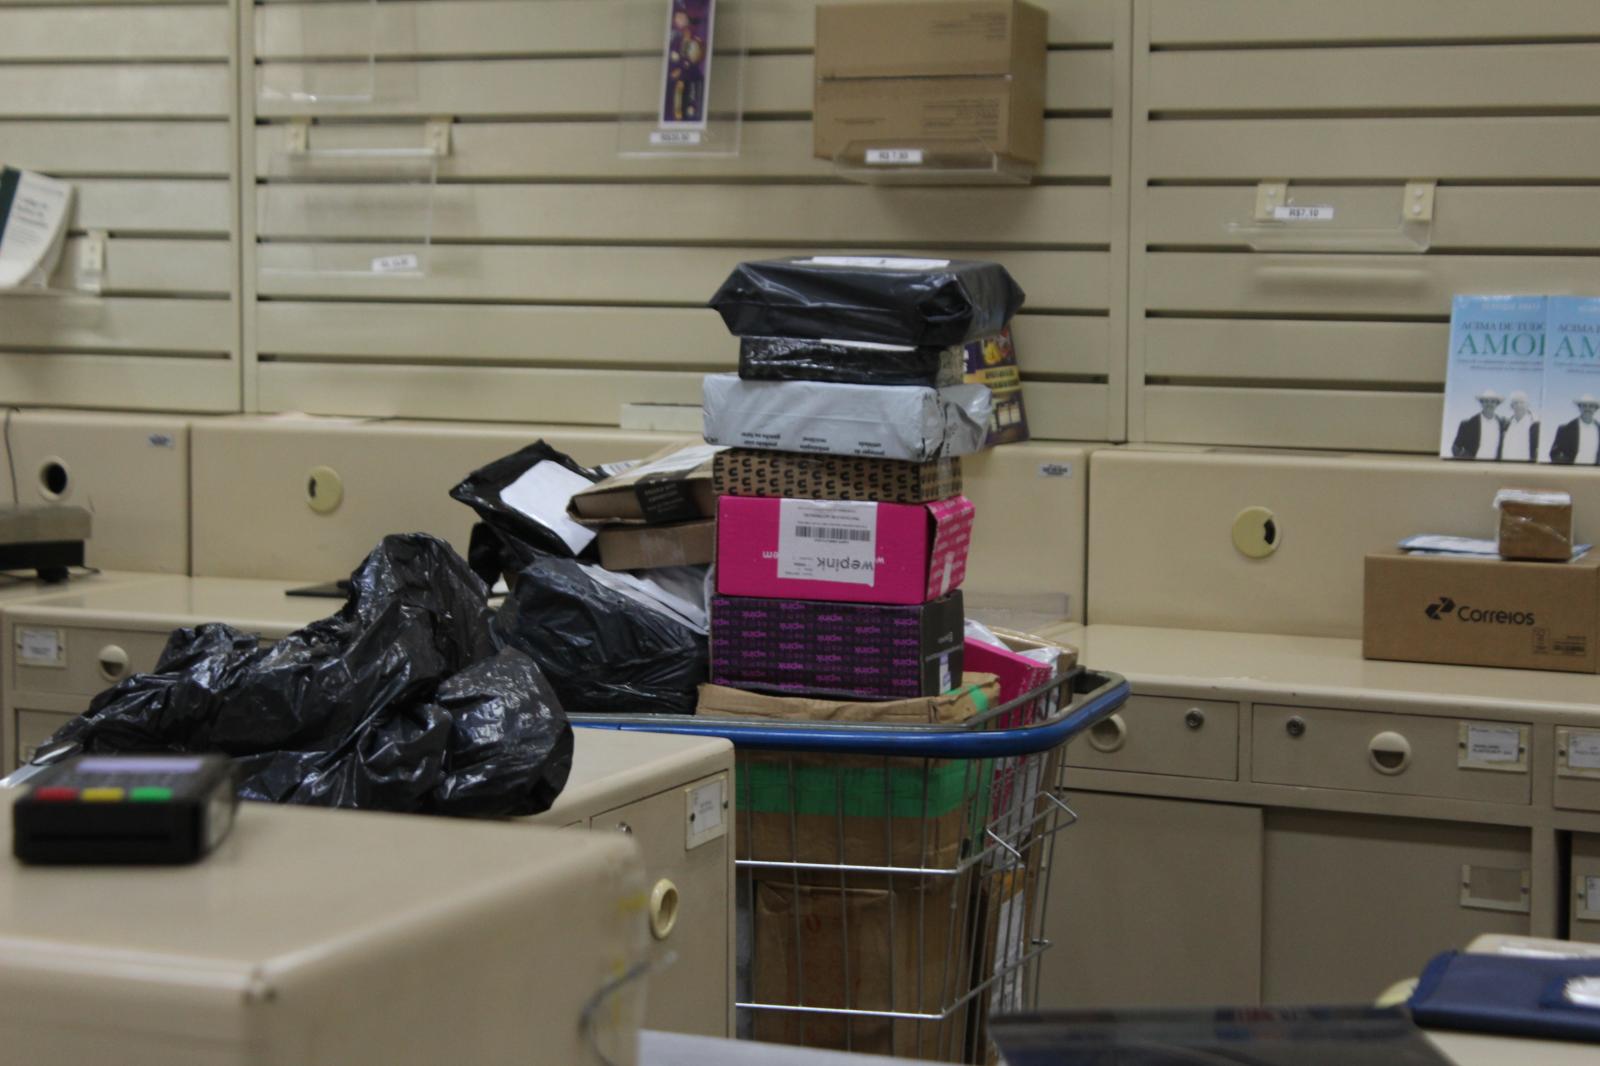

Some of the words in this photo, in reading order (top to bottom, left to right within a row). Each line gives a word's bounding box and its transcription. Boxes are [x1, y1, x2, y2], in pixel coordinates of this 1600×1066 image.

[1461, 321, 1496, 331] ACIMA
[1554, 335, 1600, 358] AM
[816, 556, 874, 572] wepink
[1457, 606, 1535, 625] Correios
